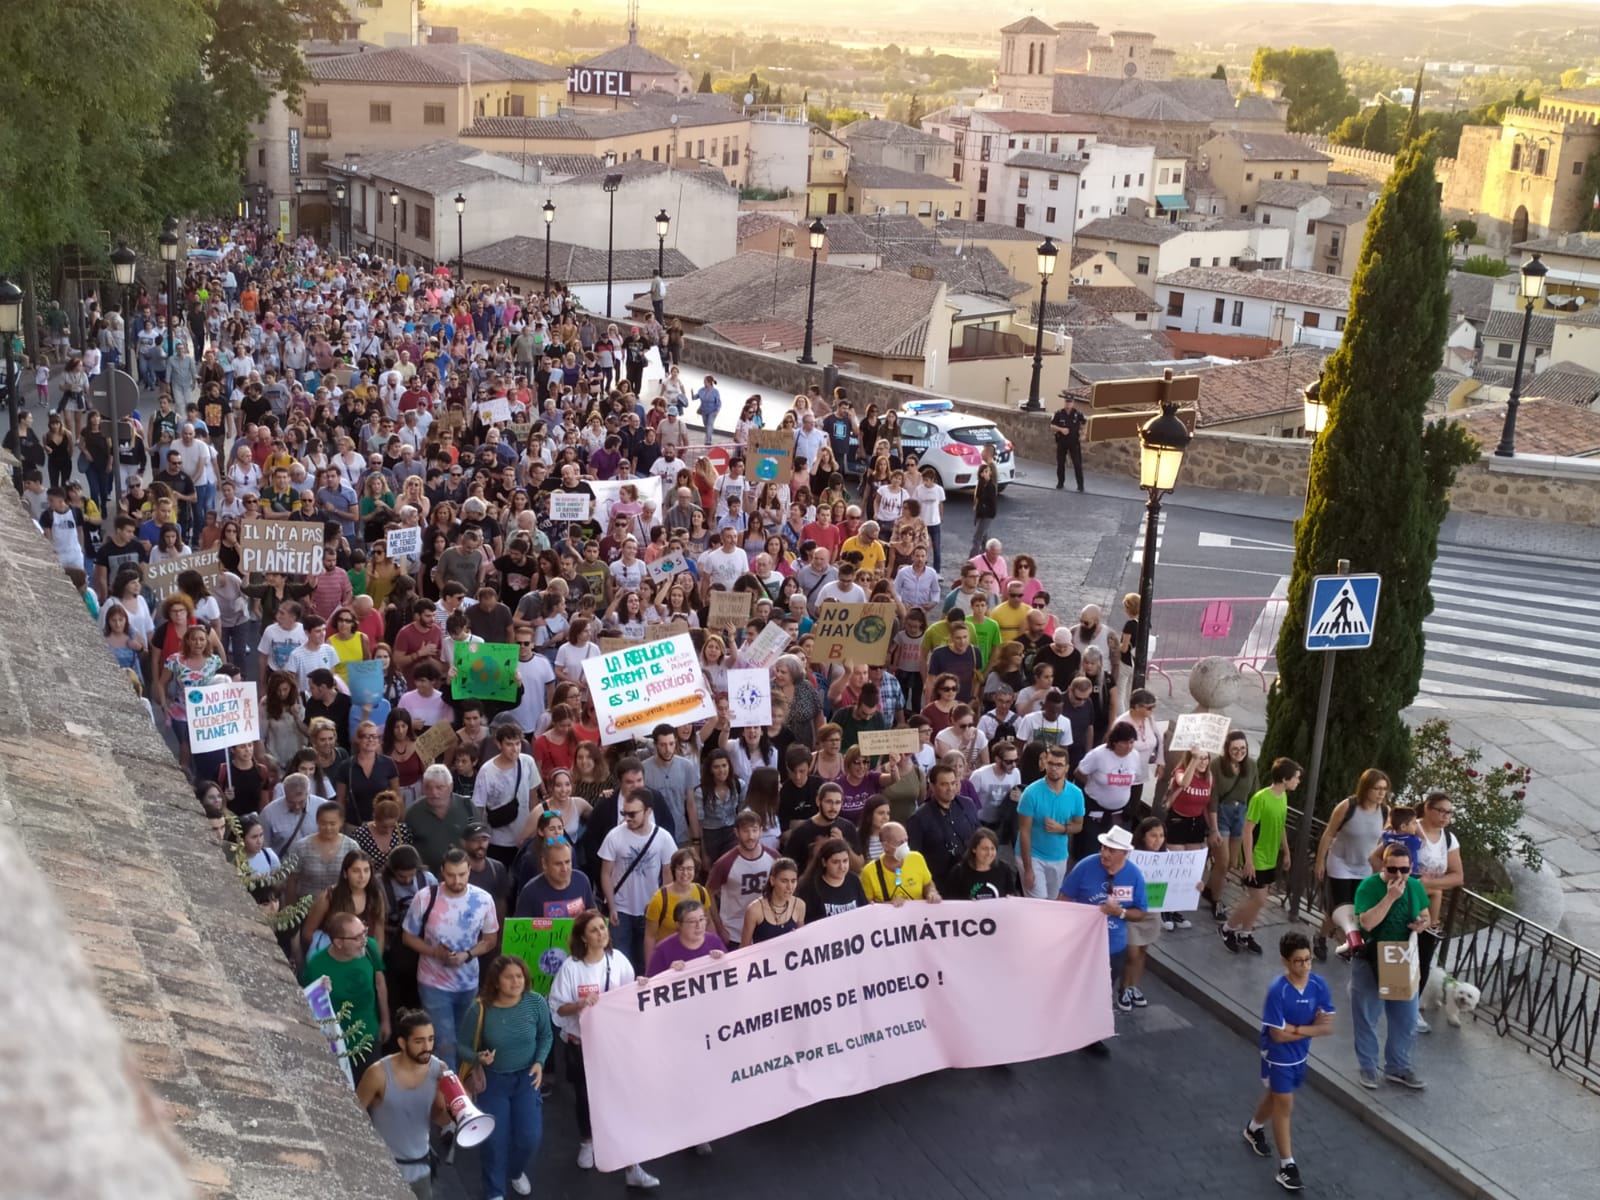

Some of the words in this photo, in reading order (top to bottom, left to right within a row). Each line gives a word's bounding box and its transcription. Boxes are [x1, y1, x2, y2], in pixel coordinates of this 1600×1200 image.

[567, 68, 630, 96] HOTEL
[290, 129, 298, 169] HOTEL
[244, 524, 260, 540] IL
[289, 526, 298, 541] A
[302, 527, 322, 543] PAS
[276, 541, 288, 551] DE
[243, 547, 311, 575] PLANÈTE
[311, 545, 324, 576] B
[824, 609, 849, 622] NO
[820, 623, 854, 638] HAY
[829, 644, 843, 659] B
[605, 656, 622, 673] LA
[601, 667, 647, 690] SUPREMA
[650, 662, 664, 675] DE
[205, 691, 219, 704] NO
[223, 688, 244, 699] HAY
[609, 694, 623, 706] ES
[625, 689, 640, 702] SU
[195, 700, 239, 717] PLANETA
[196, 722, 239, 741] PLANETA
[1136, 854, 1160, 866] OUR
[637, 967, 738, 1012] FRENTE
[746, 958, 777, 983] AL
[784, 934, 865, 970] CAMBIO
[871, 917, 997, 950] CLIMÁTICO
[717, 996, 832, 1042] CAMBIEMOS
[837, 989, 857, 1007] DE
[863, 972, 929, 1000] MODELO
[730, 1055, 794, 1084] ALIANZA
[796, 1046, 824, 1064] POR
[827, 1040, 843, 1055] EL
[846, 1030, 884, 1050] CLIMA
